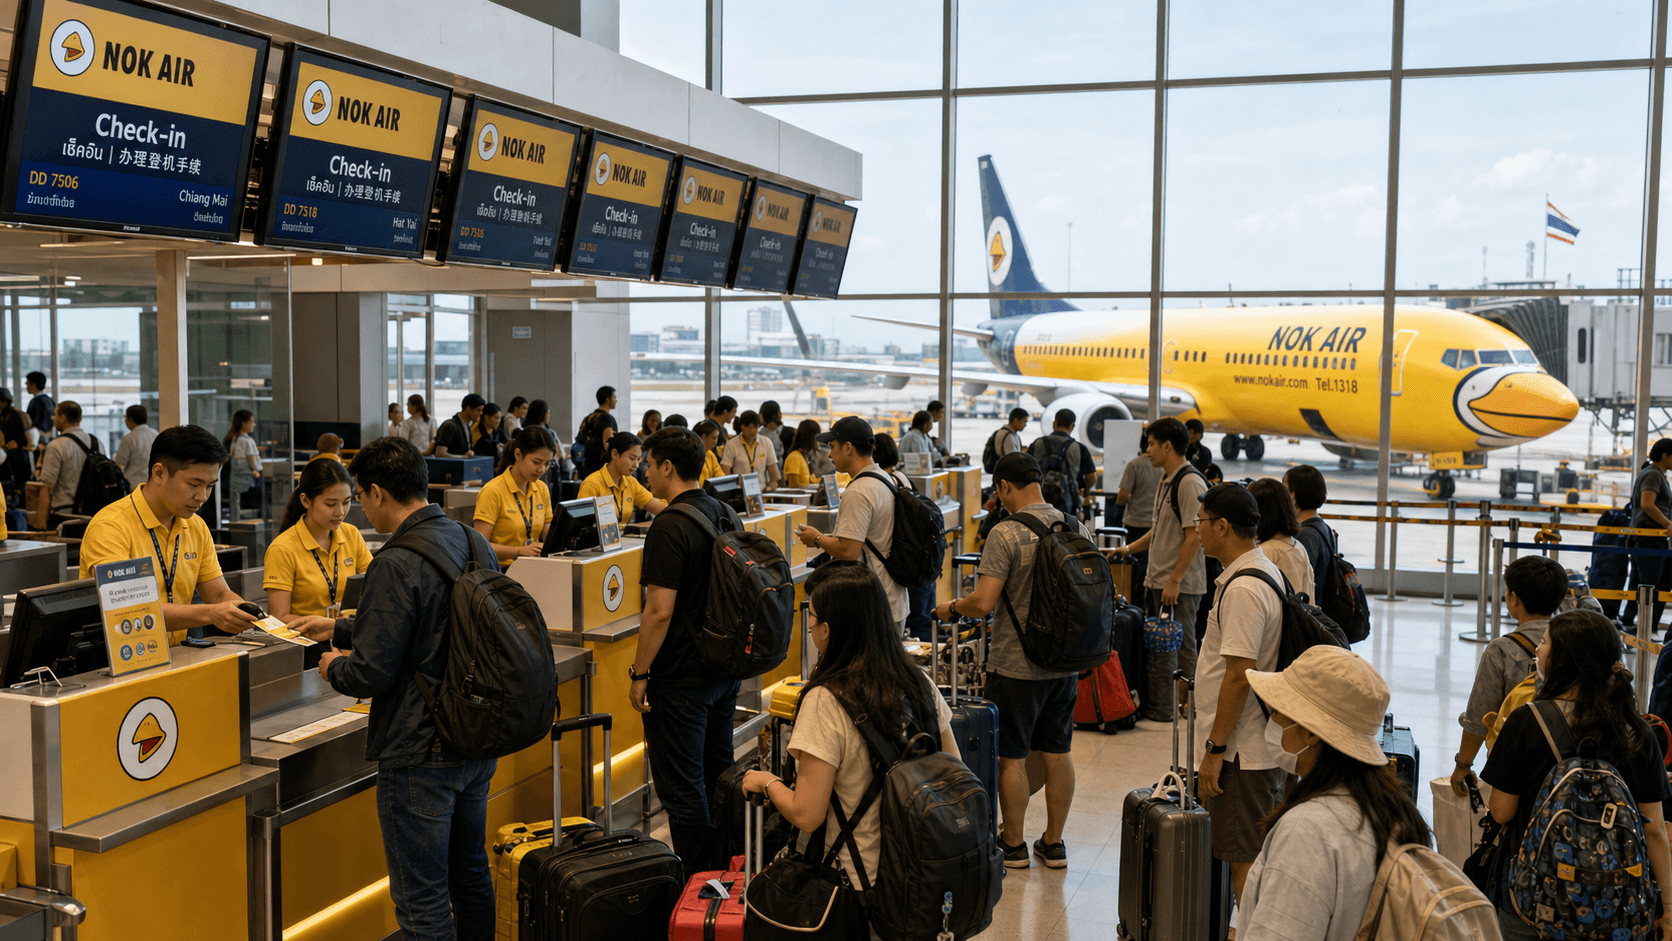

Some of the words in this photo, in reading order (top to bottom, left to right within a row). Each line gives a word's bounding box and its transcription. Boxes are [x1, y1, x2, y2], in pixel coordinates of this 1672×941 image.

[103, 41, 155, 79] NOK
[157, 53, 195, 87] AIR
[337, 96, 373, 126] NOK
[374, 105, 400, 131] AIR
[95, 113, 186, 149] Check-in
[119, 147, 201, 175] 办理登机手续
[501, 136, 527, 160] NOK
[526, 142, 546, 164] AIR
[29, 170, 48, 185] DD
[51, 173, 79, 189] 7506
[329, 155, 392, 183] Check-in
[612, 163, 632, 184] NOK
[632, 168, 647, 187] AIR
[179, 189, 210, 207] Chiang
[212, 193, 228, 207] Mai
[493, 185, 536, 207] Check-in
[697, 185, 713, 203] NOK
[712, 189, 725, 206] AIR
[283, 203, 296, 215] DD
[298, 205, 318, 218] 7518
[605, 206, 638, 225] Check-in
[1267, 326, 1323, 351] NOK
[1318, 326, 1366, 353] AIR
[1234, 374, 1308, 389] www.nokair.com
[1315, 377, 1358, 394] Tel.1318
